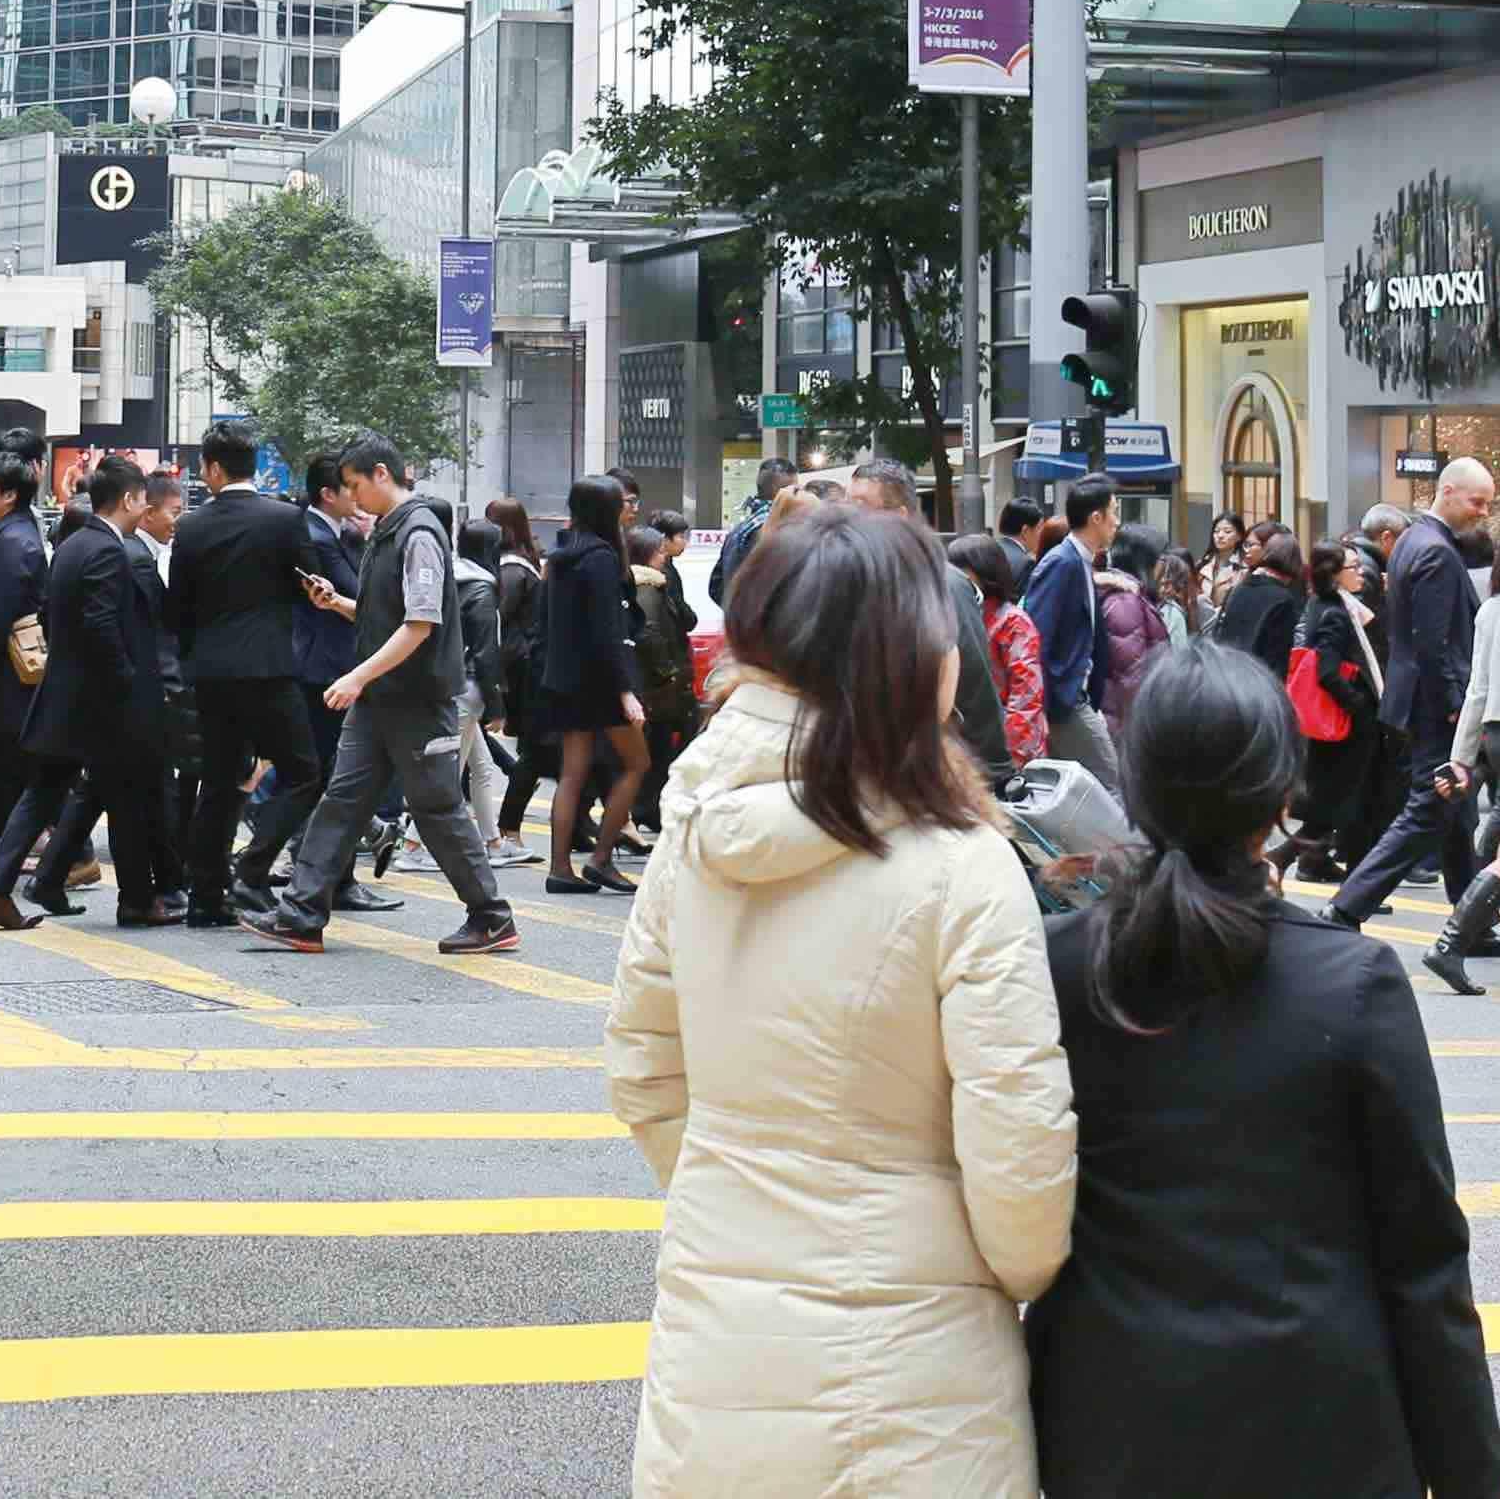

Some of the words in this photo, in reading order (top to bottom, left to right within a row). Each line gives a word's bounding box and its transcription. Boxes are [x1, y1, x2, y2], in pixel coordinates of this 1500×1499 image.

[923, 6, 984, 21] 3-7/3/2016
[923, 22, 962, 35] HKCEC
[1187, 204, 1270, 240] BOUCHERON
[1387, 269, 1486, 312] SWAROVSKI
[1220, 318, 1293, 344] BOUCHERON
[641, 397, 671, 419] VERTU
